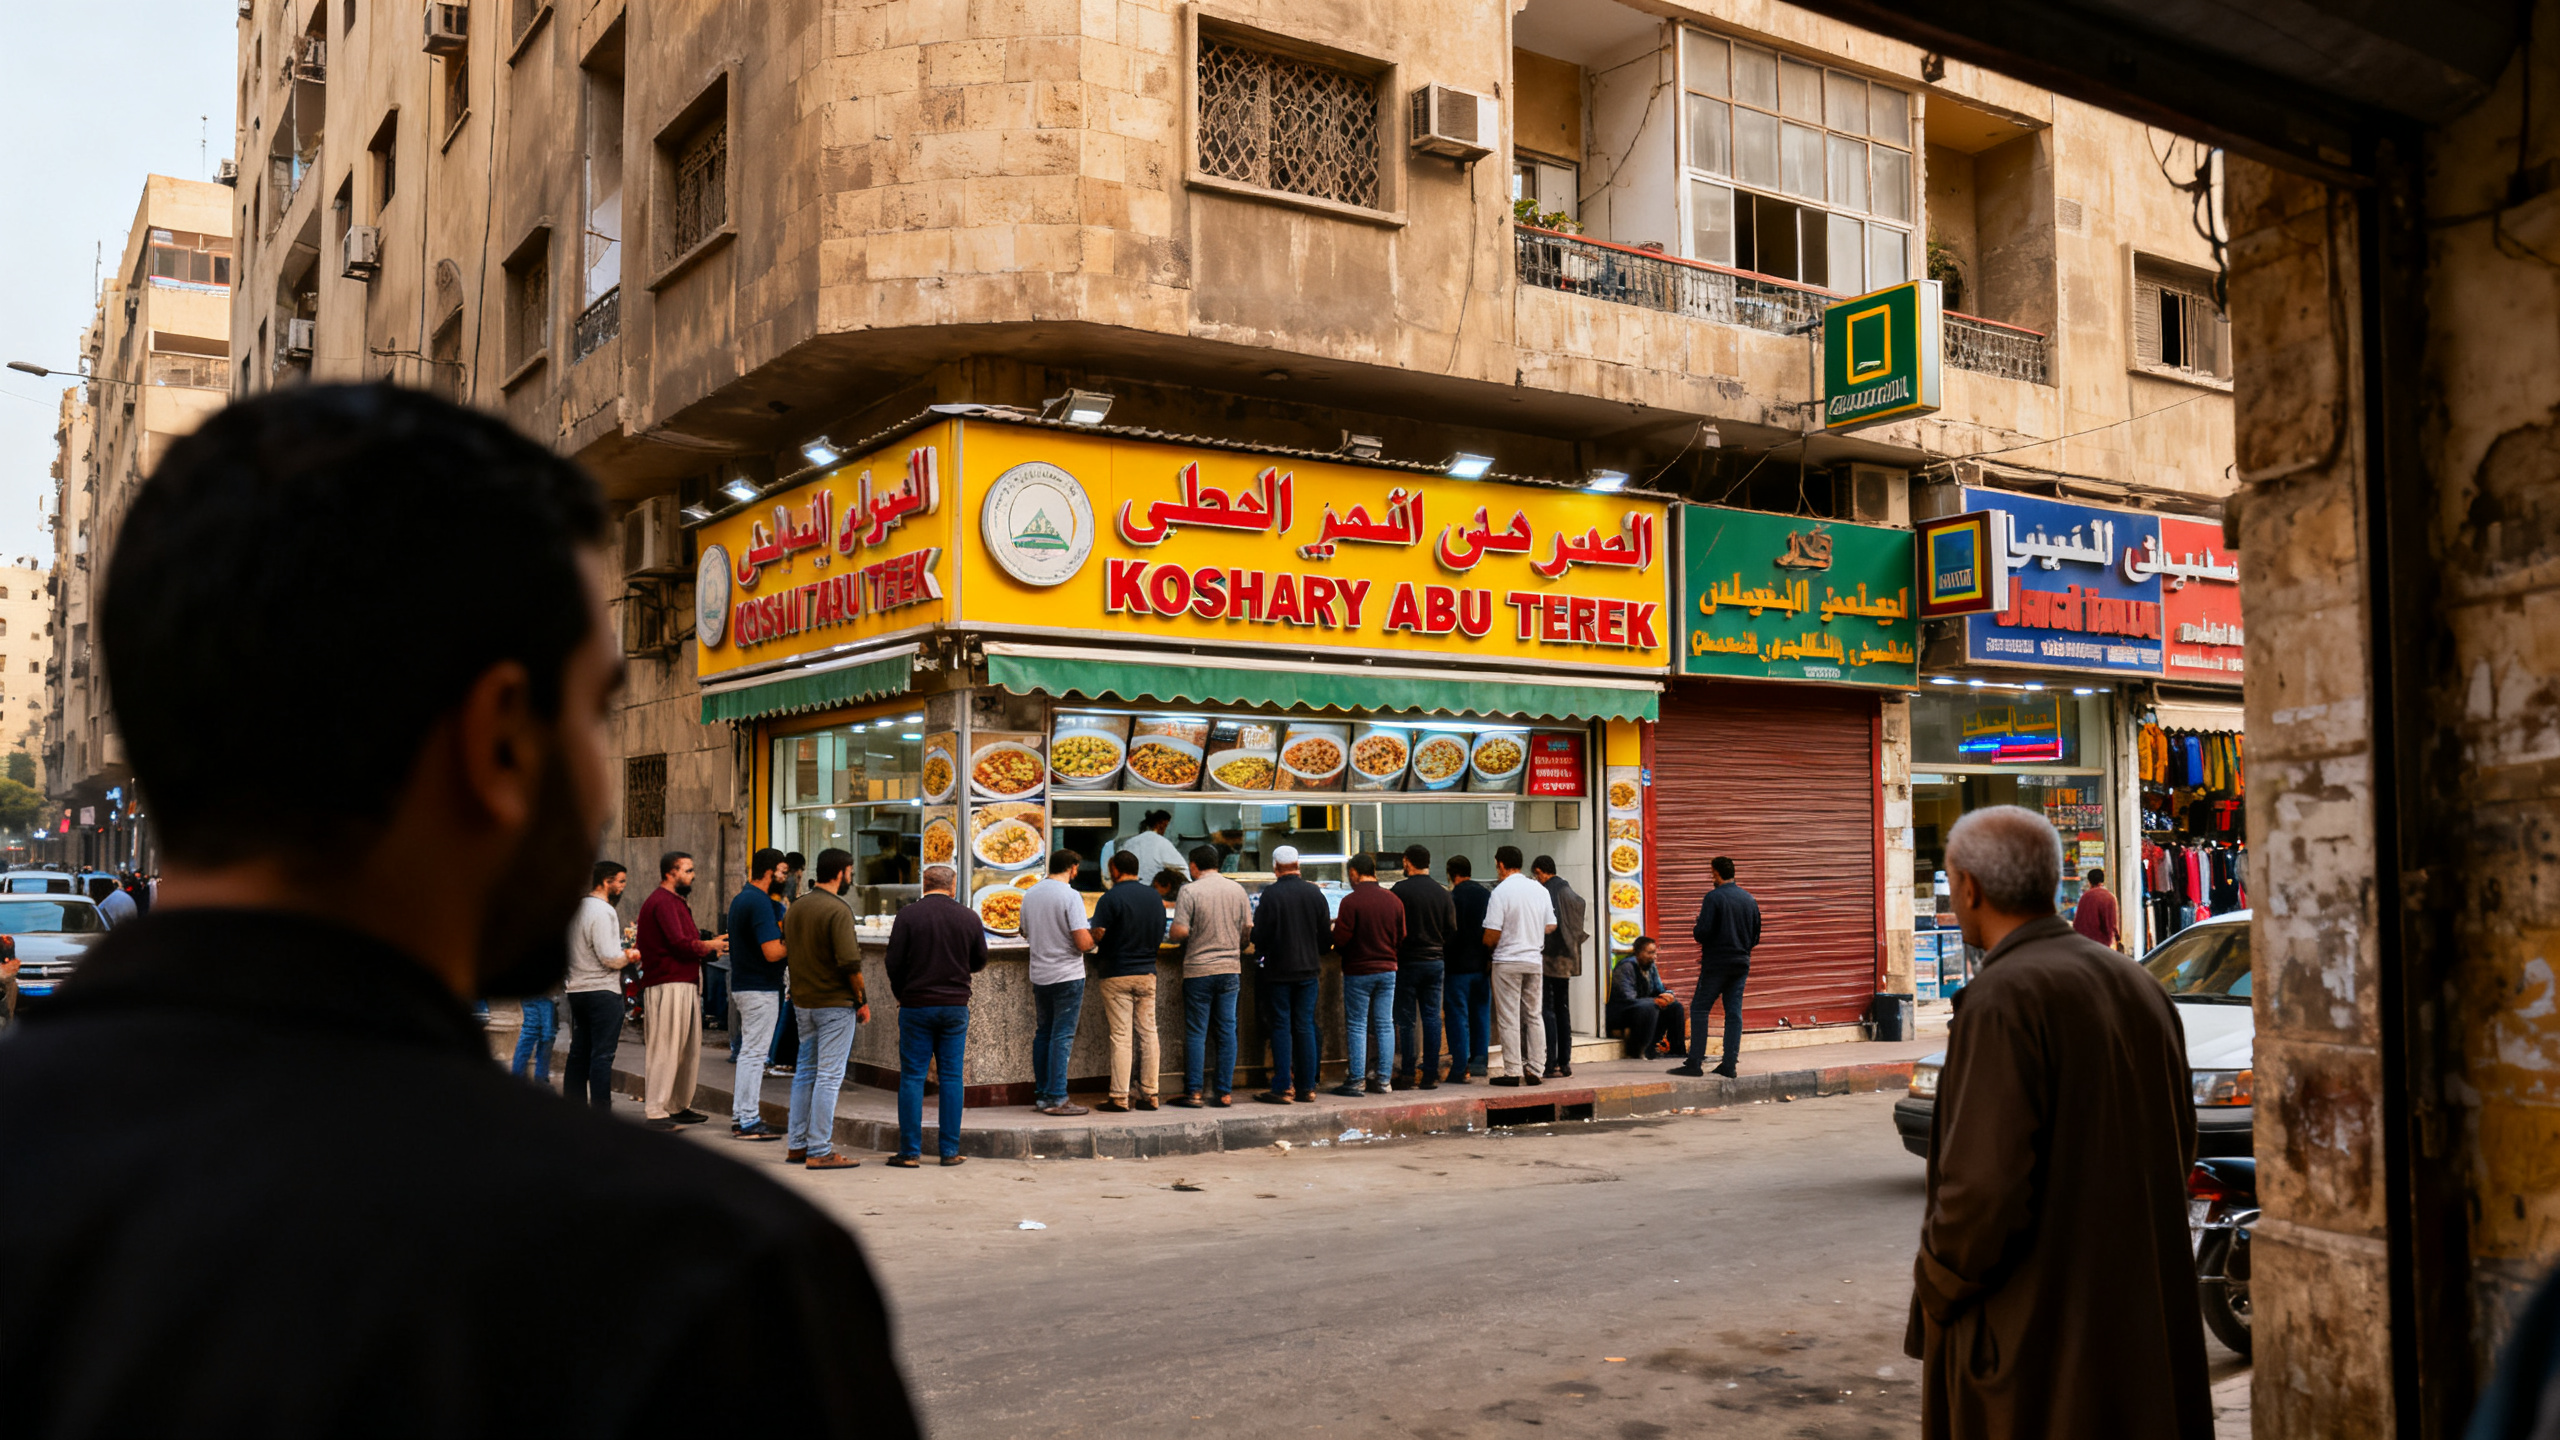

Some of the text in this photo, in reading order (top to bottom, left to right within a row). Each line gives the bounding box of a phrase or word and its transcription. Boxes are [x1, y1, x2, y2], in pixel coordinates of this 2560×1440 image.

[1105, 556, 1372, 629] KOSHARY
[1383, 581, 1494, 638] ABU
[1505, 590, 1661, 649] TEREK
